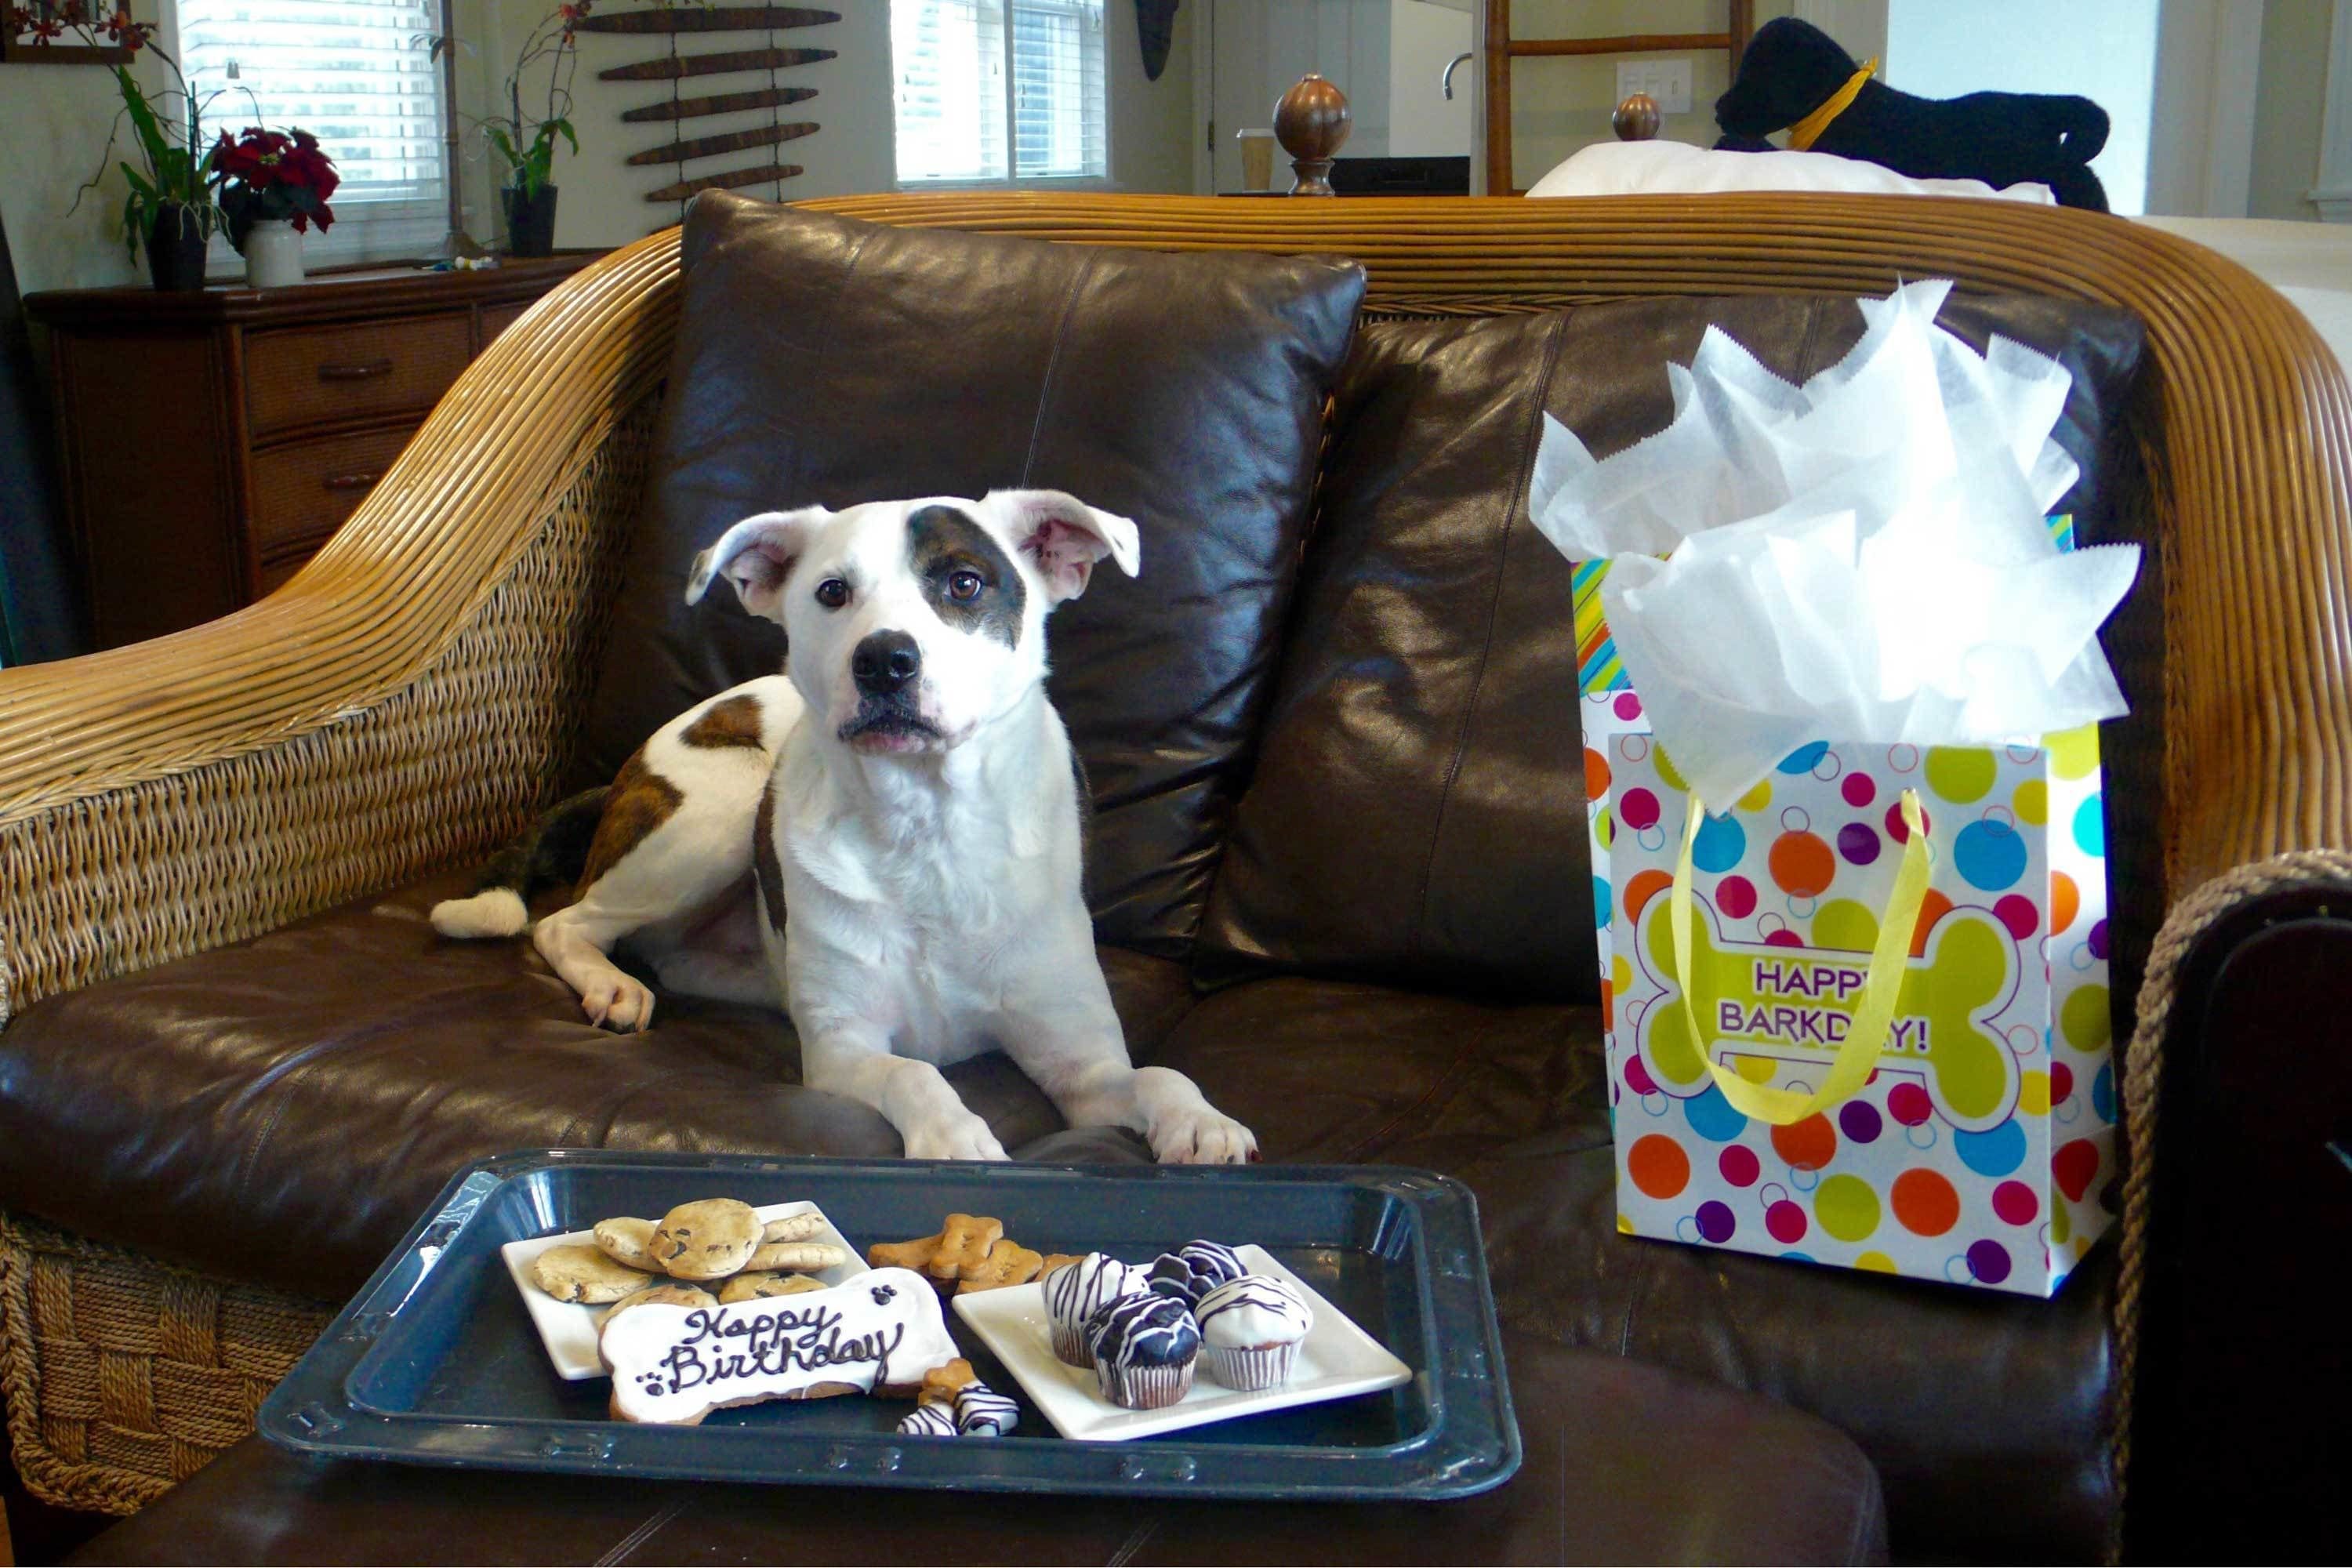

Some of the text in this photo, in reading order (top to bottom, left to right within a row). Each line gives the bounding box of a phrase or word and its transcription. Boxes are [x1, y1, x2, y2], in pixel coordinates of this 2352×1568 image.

[1755, 962, 1869, 999] HAPP
[1719, 1001, 1928, 1051] BARKDY!
[681, 1305, 843, 1350] Happy
[660, 1323, 904, 1394] Birthday
